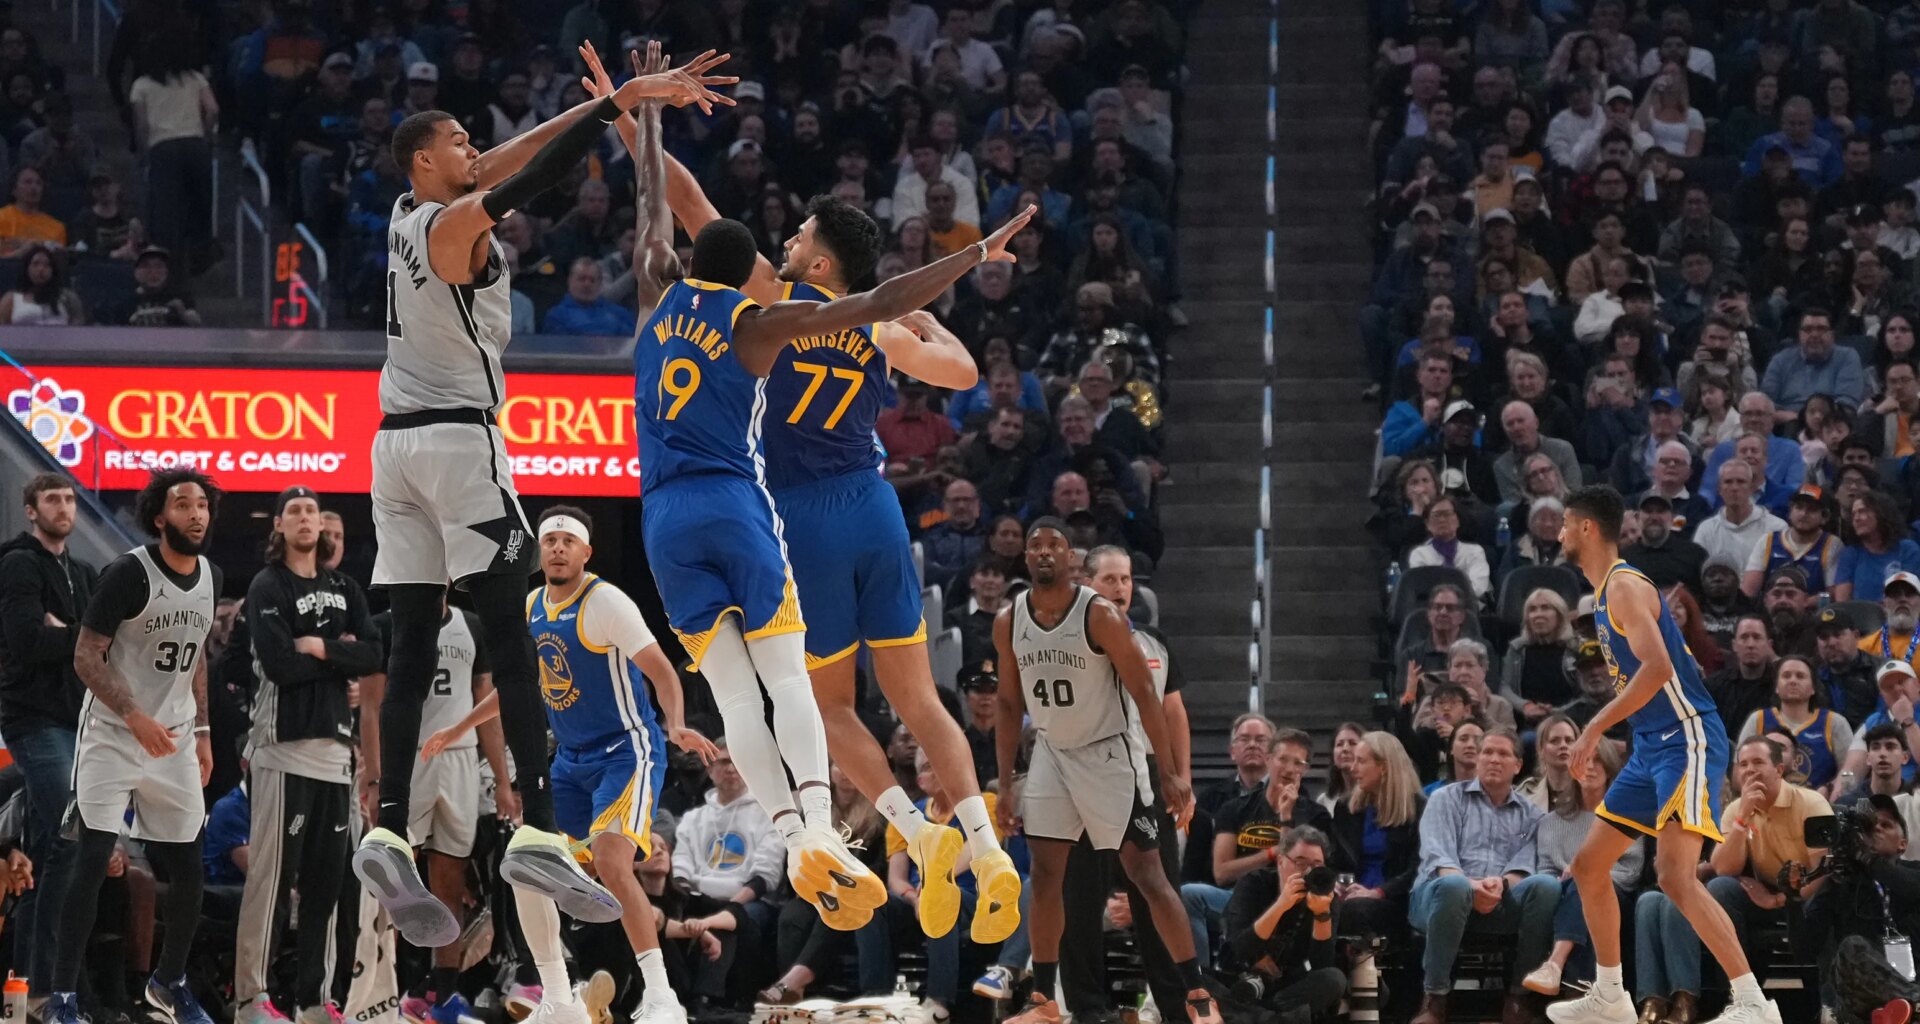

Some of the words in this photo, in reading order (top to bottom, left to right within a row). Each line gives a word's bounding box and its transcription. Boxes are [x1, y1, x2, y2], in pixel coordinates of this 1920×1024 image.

[387, 269, 403, 340] 1
[653, 314, 729, 361] WILLIAMS
[786, 361, 865, 430] 77
[108, 389, 337, 441] GRATON
[497, 395, 637, 446] GRAT
[104, 450, 213, 470] RESORT
[216, 452, 235, 471] &
[604, 457, 623, 477] &
[145, 613, 171, 634] SAN
[154, 641, 198, 673] 30
[551, 655, 563, 672] 31
[1018, 652, 1035, 672] SAN
[1037, 649, 1086, 669] ANTONIO
[1032, 678, 1075, 708] 40
[355, 996, 400, 1022] GATO
